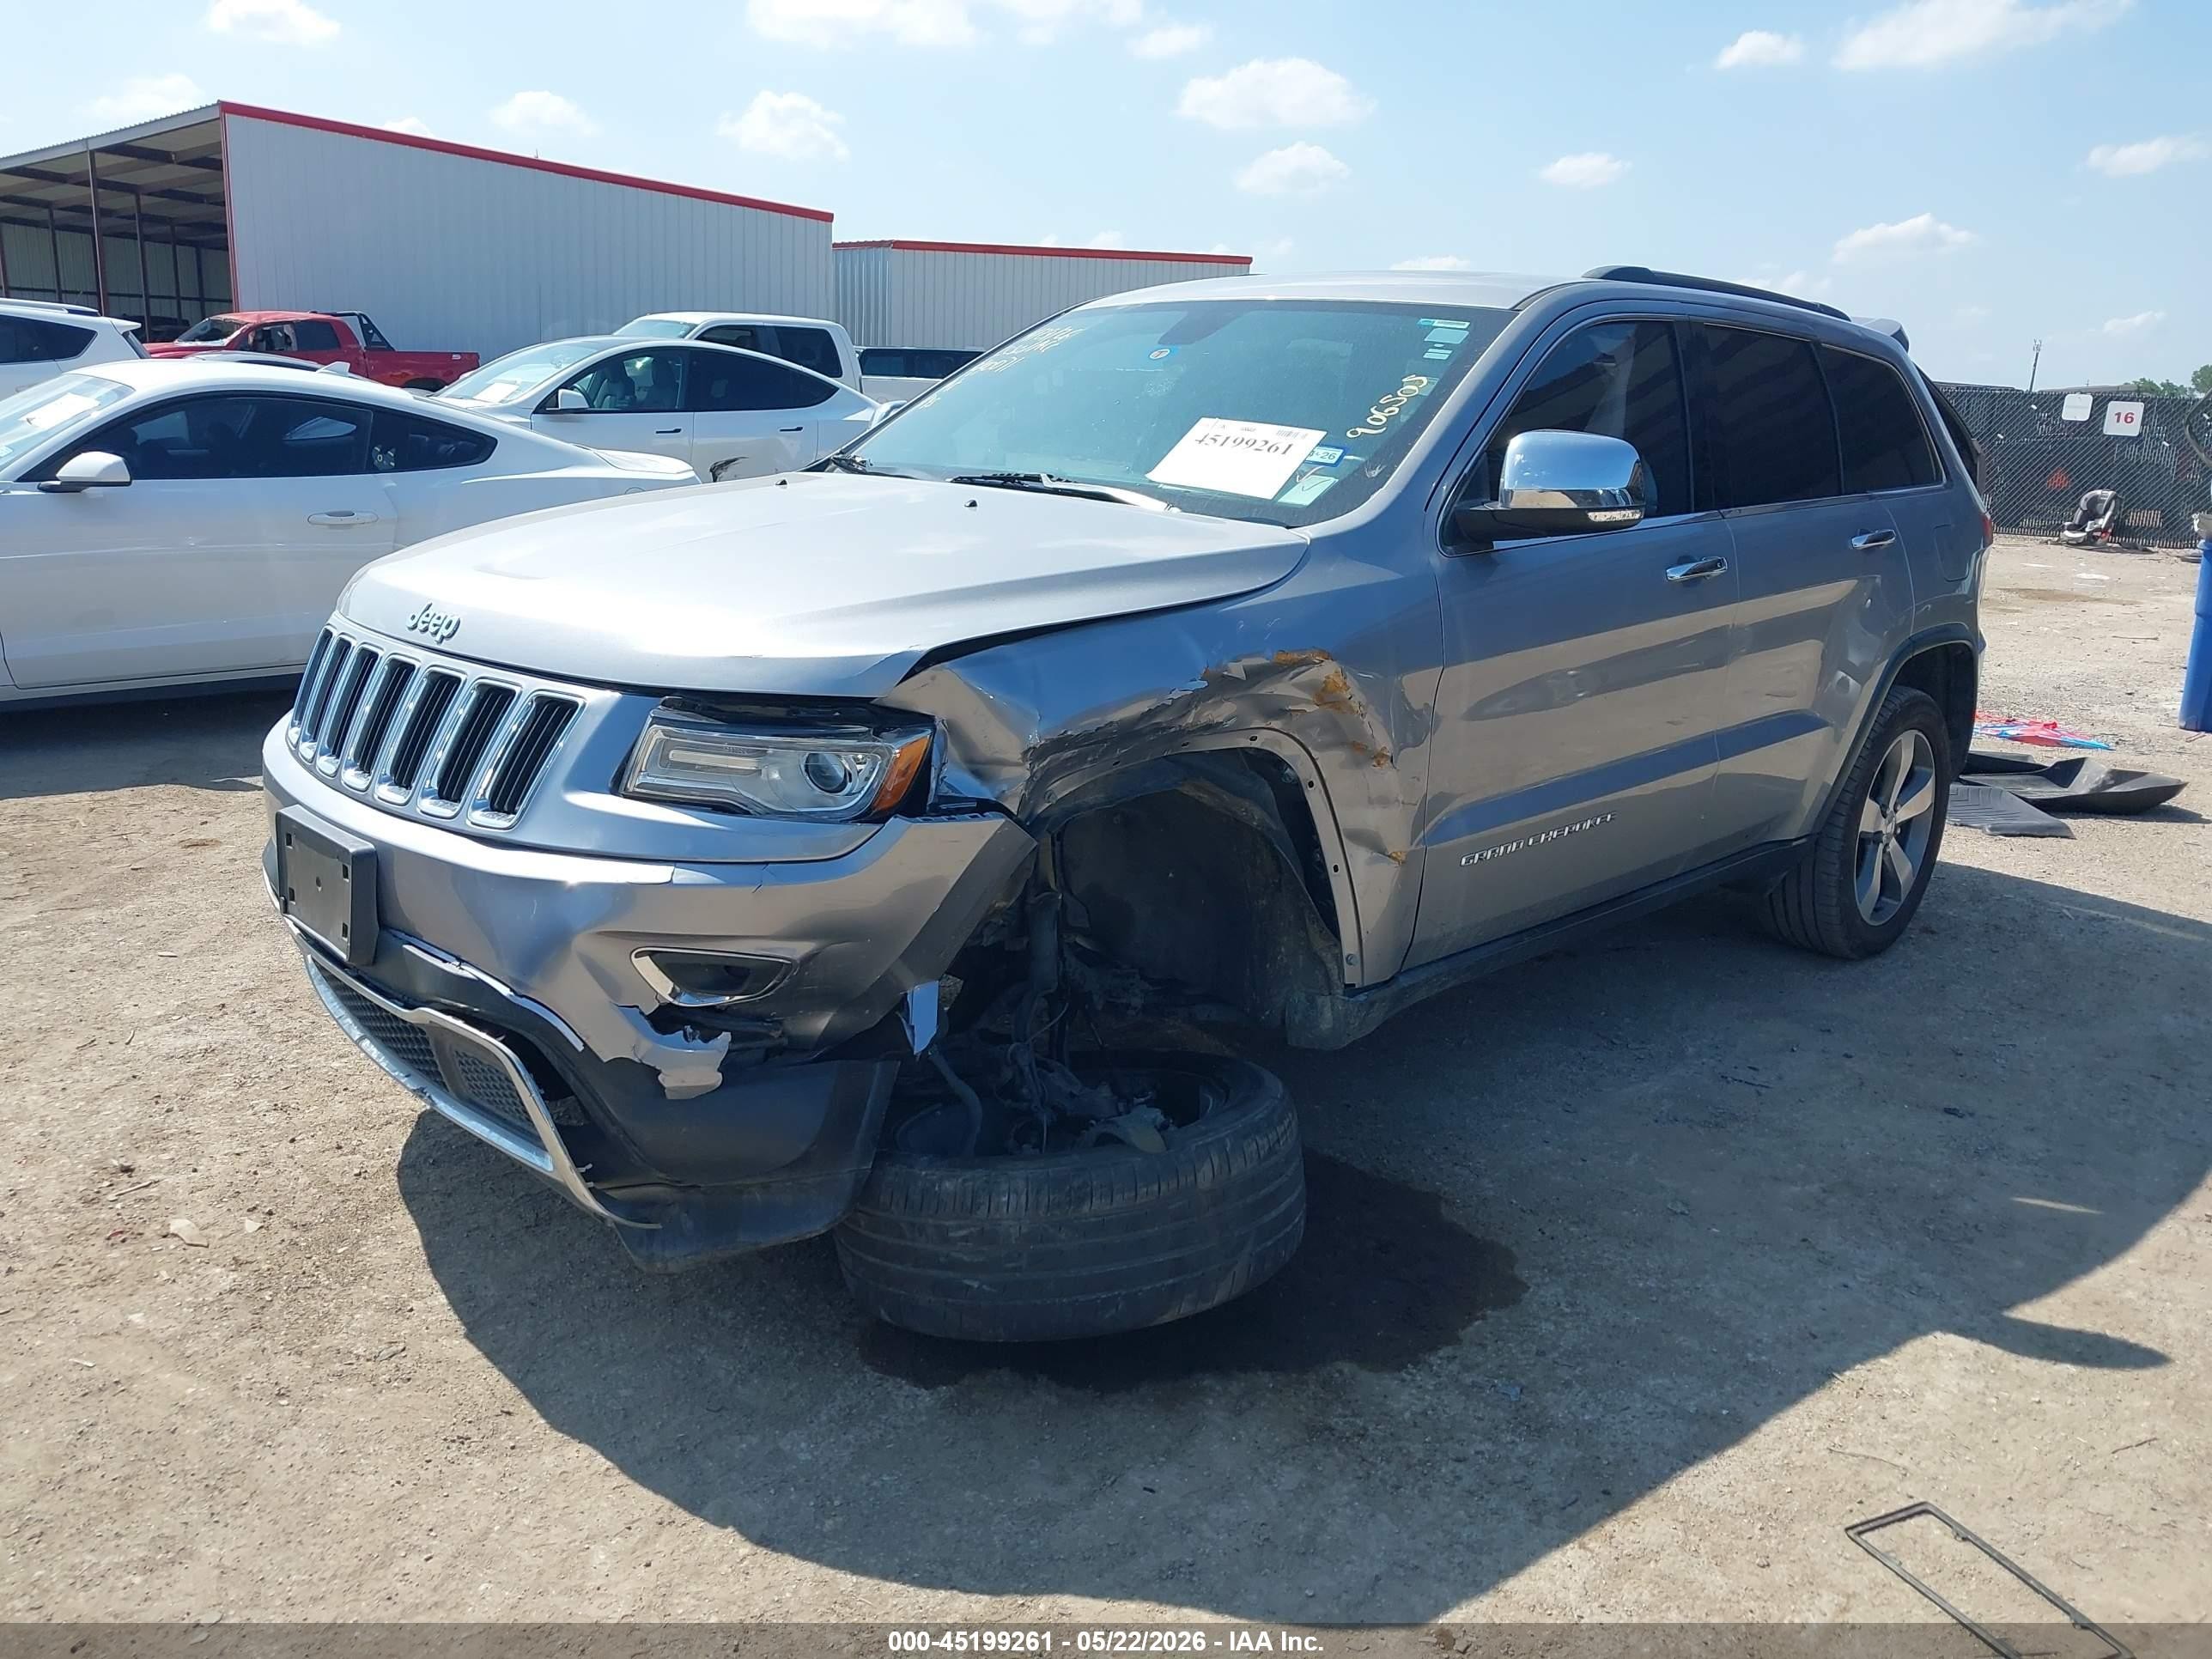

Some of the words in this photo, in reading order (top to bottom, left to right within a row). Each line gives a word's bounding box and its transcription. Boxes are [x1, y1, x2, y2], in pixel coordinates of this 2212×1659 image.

[2114, 411, 2135, 424] 16
[1194, 432, 1294, 455] 45199261
[406, 601, 461, 645] Jeep
[1460, 839, 1524, 866] GRAND
